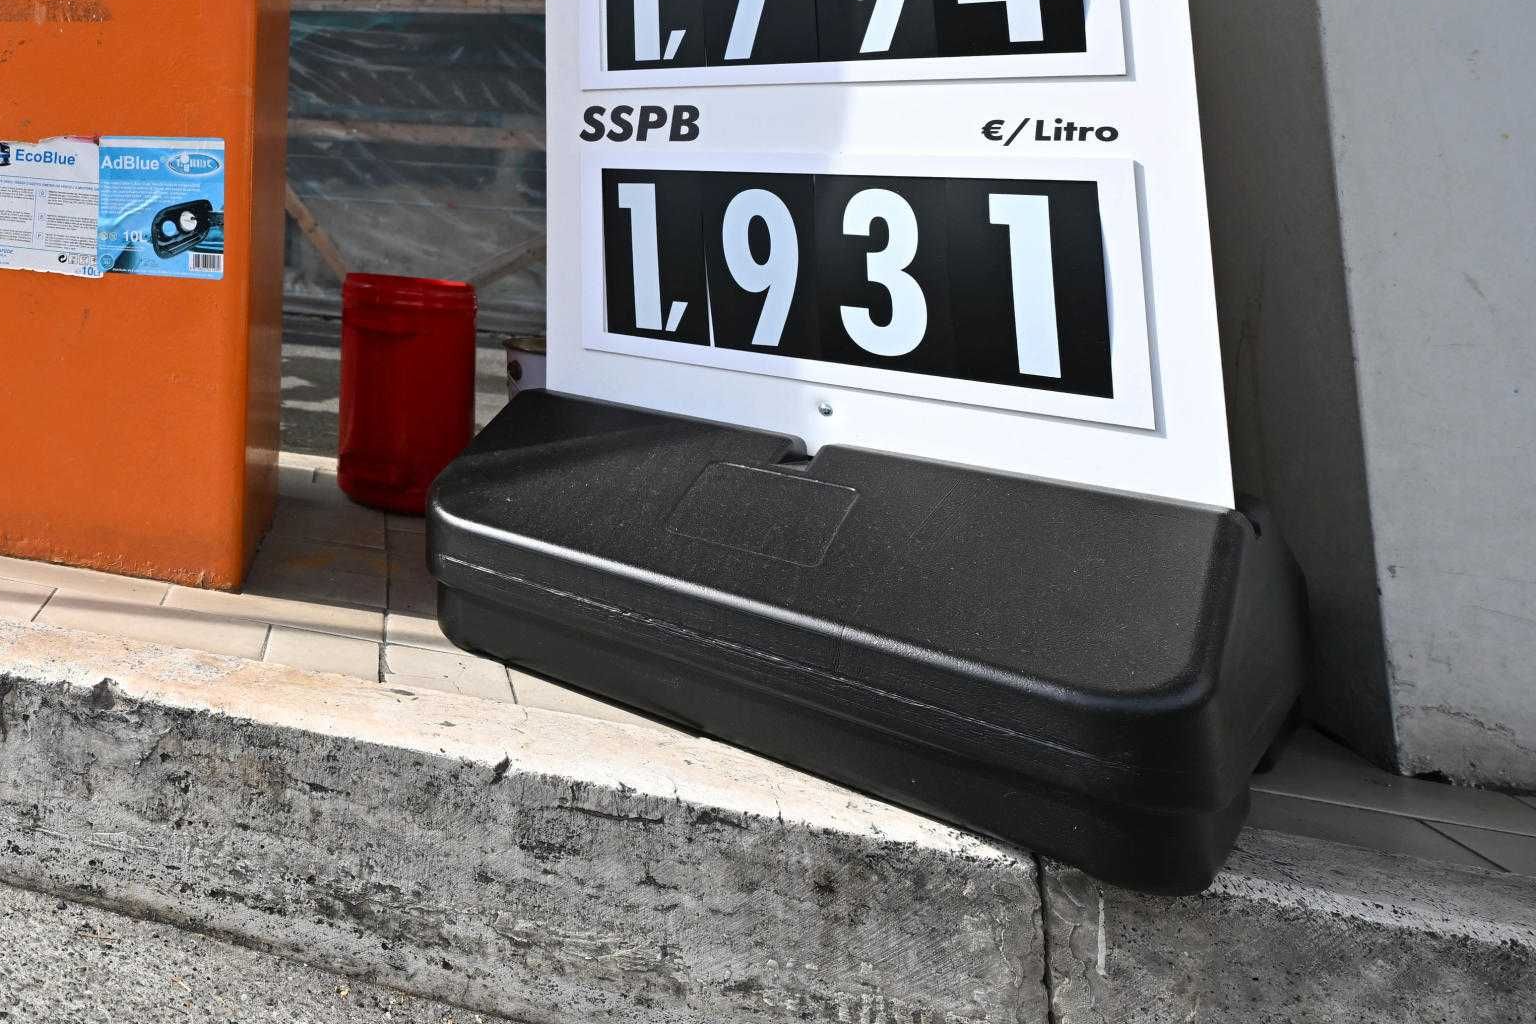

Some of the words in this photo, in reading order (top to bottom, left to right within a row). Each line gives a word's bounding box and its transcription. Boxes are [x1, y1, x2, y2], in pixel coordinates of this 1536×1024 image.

[579, 104, 701, 143] SSPB
[15, 148, 76, 165] EcoBlue
[101, 154, 160, 170] AdBlue
[618, 182, 1062, 379] 1,931
